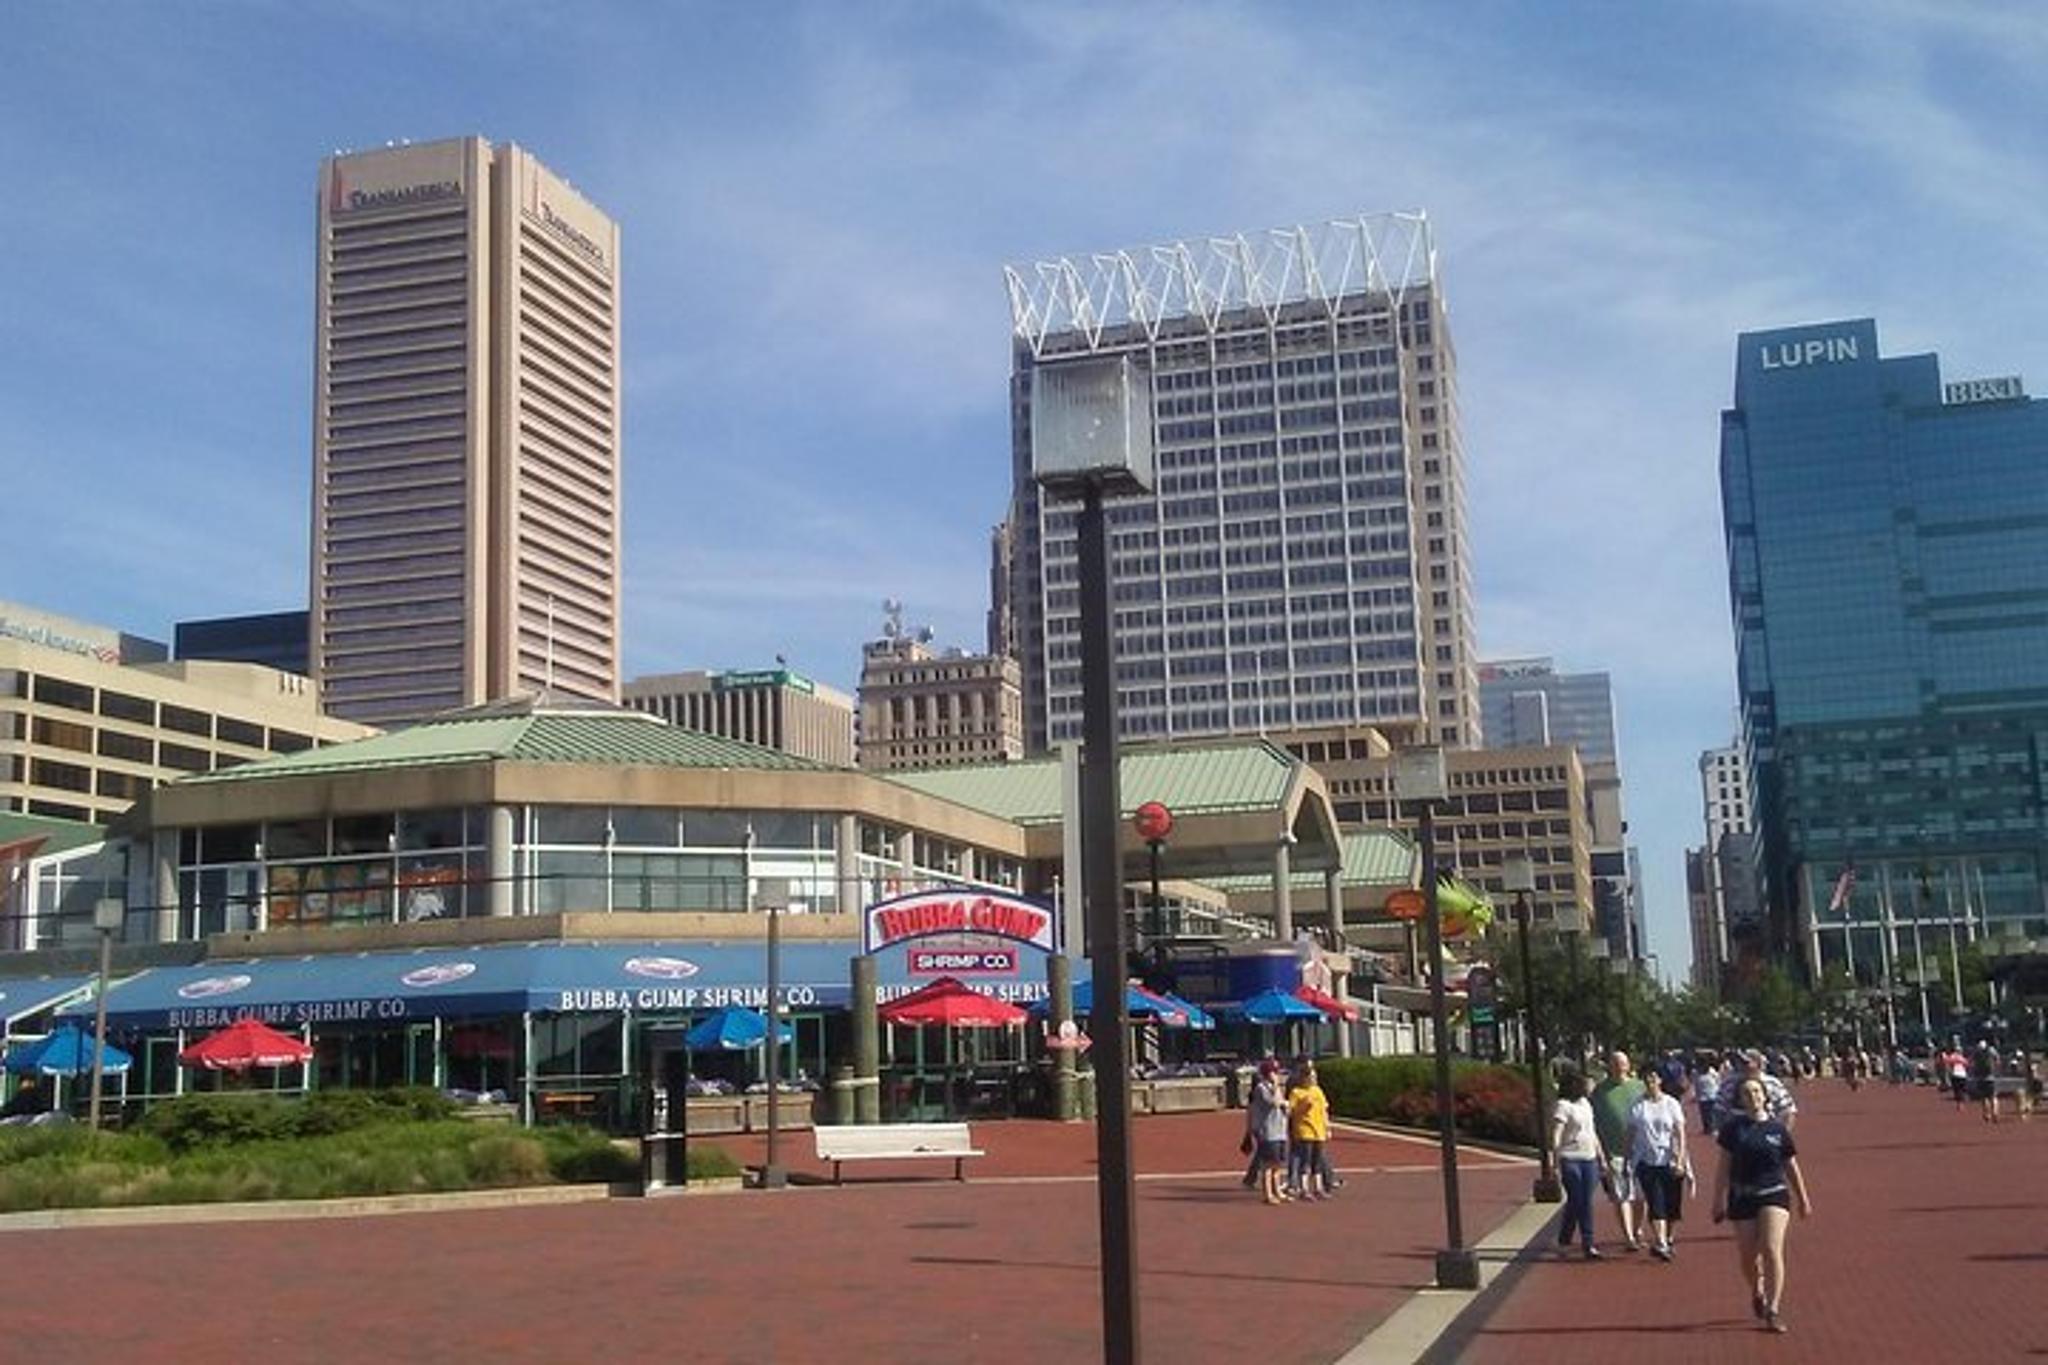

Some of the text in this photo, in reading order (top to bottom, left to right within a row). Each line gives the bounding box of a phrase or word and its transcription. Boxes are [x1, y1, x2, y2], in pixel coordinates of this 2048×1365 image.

[1761, 336, 1858, 369] LUPIN
[876, 898, 1047, 941] BUBBA GUMP
[918, 954, 980, 970] SHRIMP
[562, 985, 821, 1010] BUBBA GUMP SHRIM CO.
[169, 1009, 232, 1028] BUBBA
[237, 1004, 292, 1023] GUMP
[297, 1000, 371, 1022] SHRIMP
